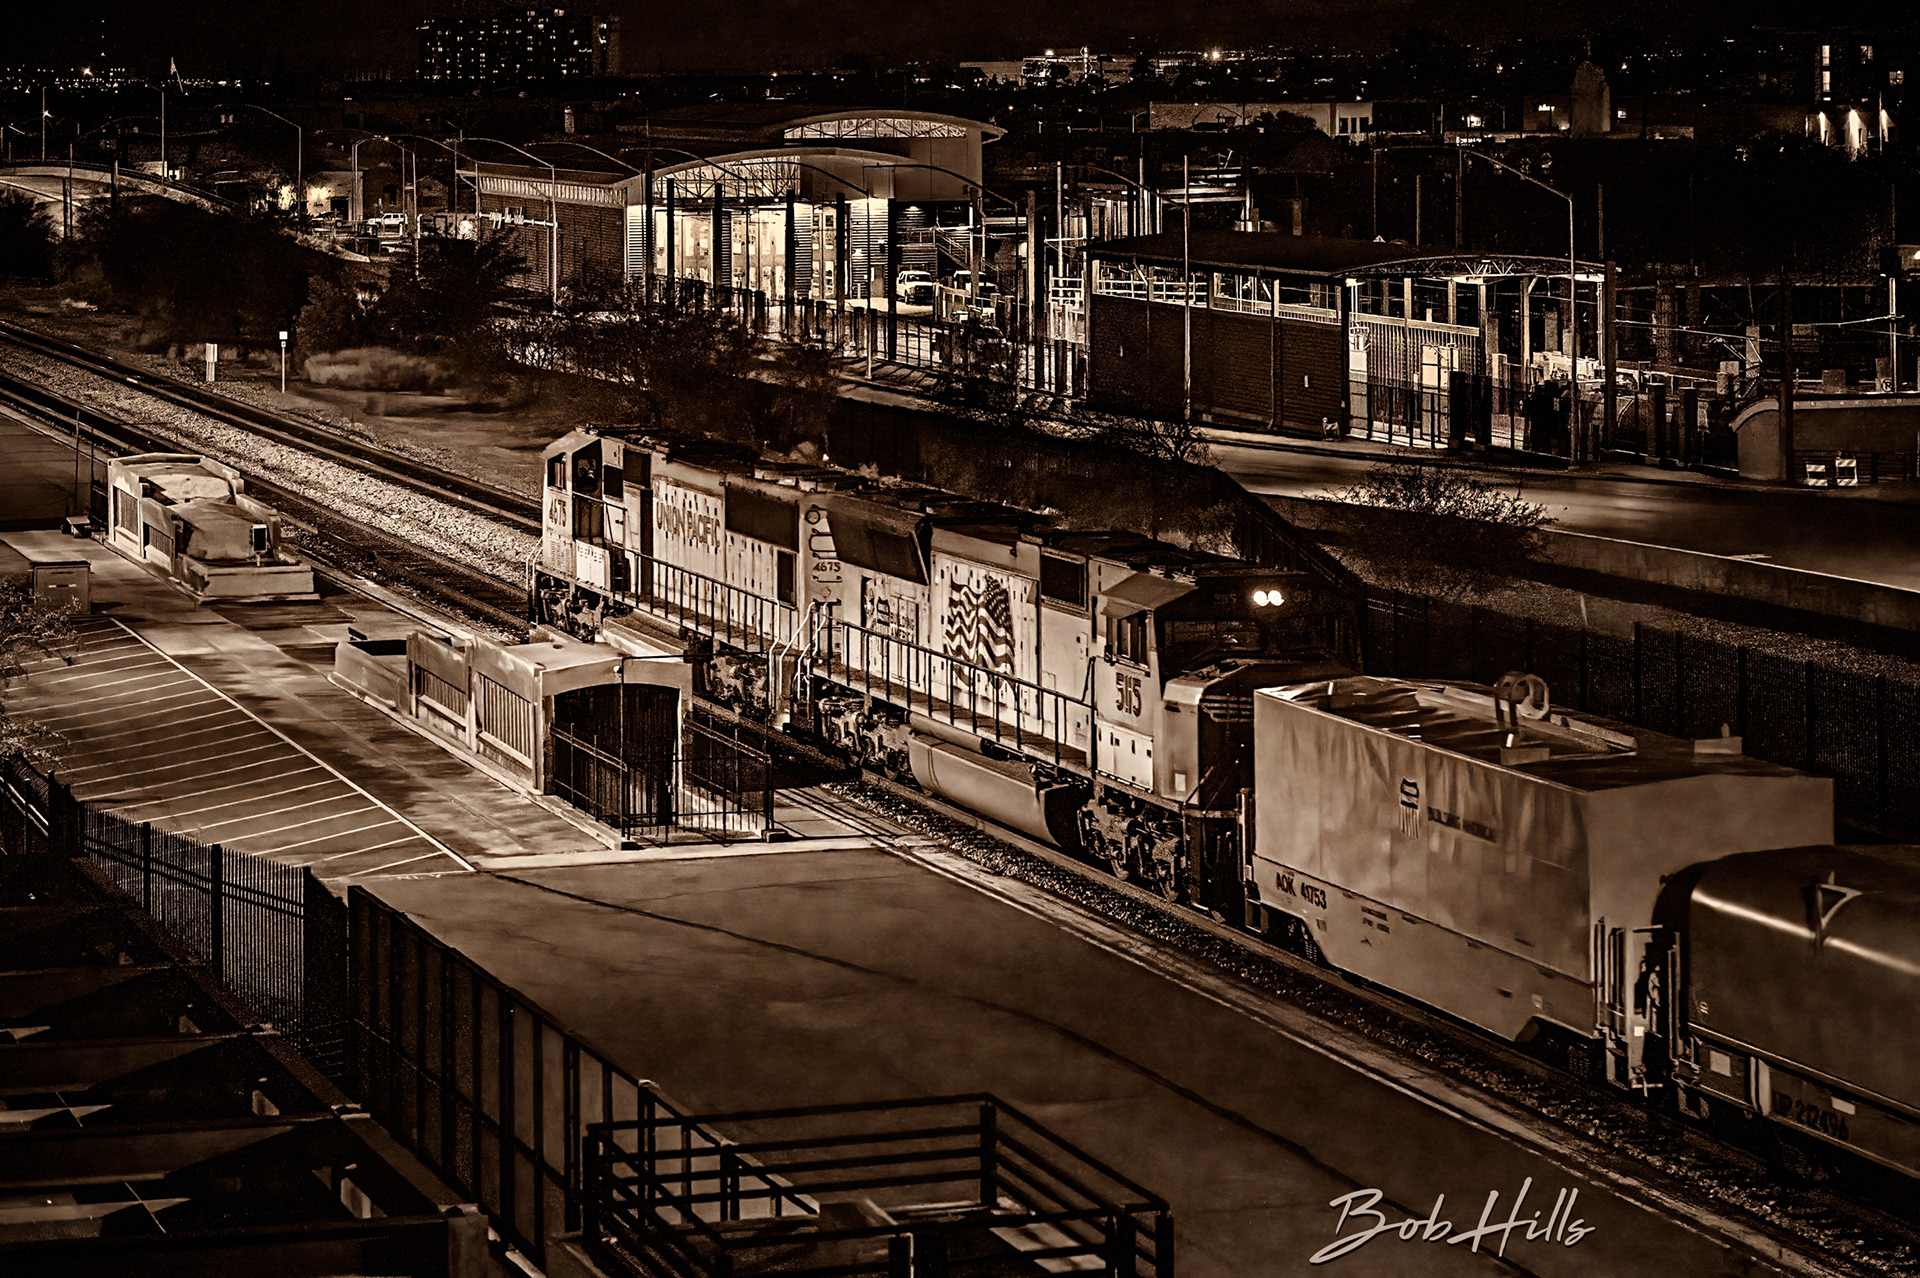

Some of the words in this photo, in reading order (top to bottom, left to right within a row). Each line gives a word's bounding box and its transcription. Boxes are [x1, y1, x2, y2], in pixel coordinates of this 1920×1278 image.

[548, 497, 567, 527] 4675
[656, 501, 686, 538] UNION
[686, 509, 721, 549] PACIFIC
[812, 560, 842, 573] 4675
[1276, 871, 1297, 897] AOK
